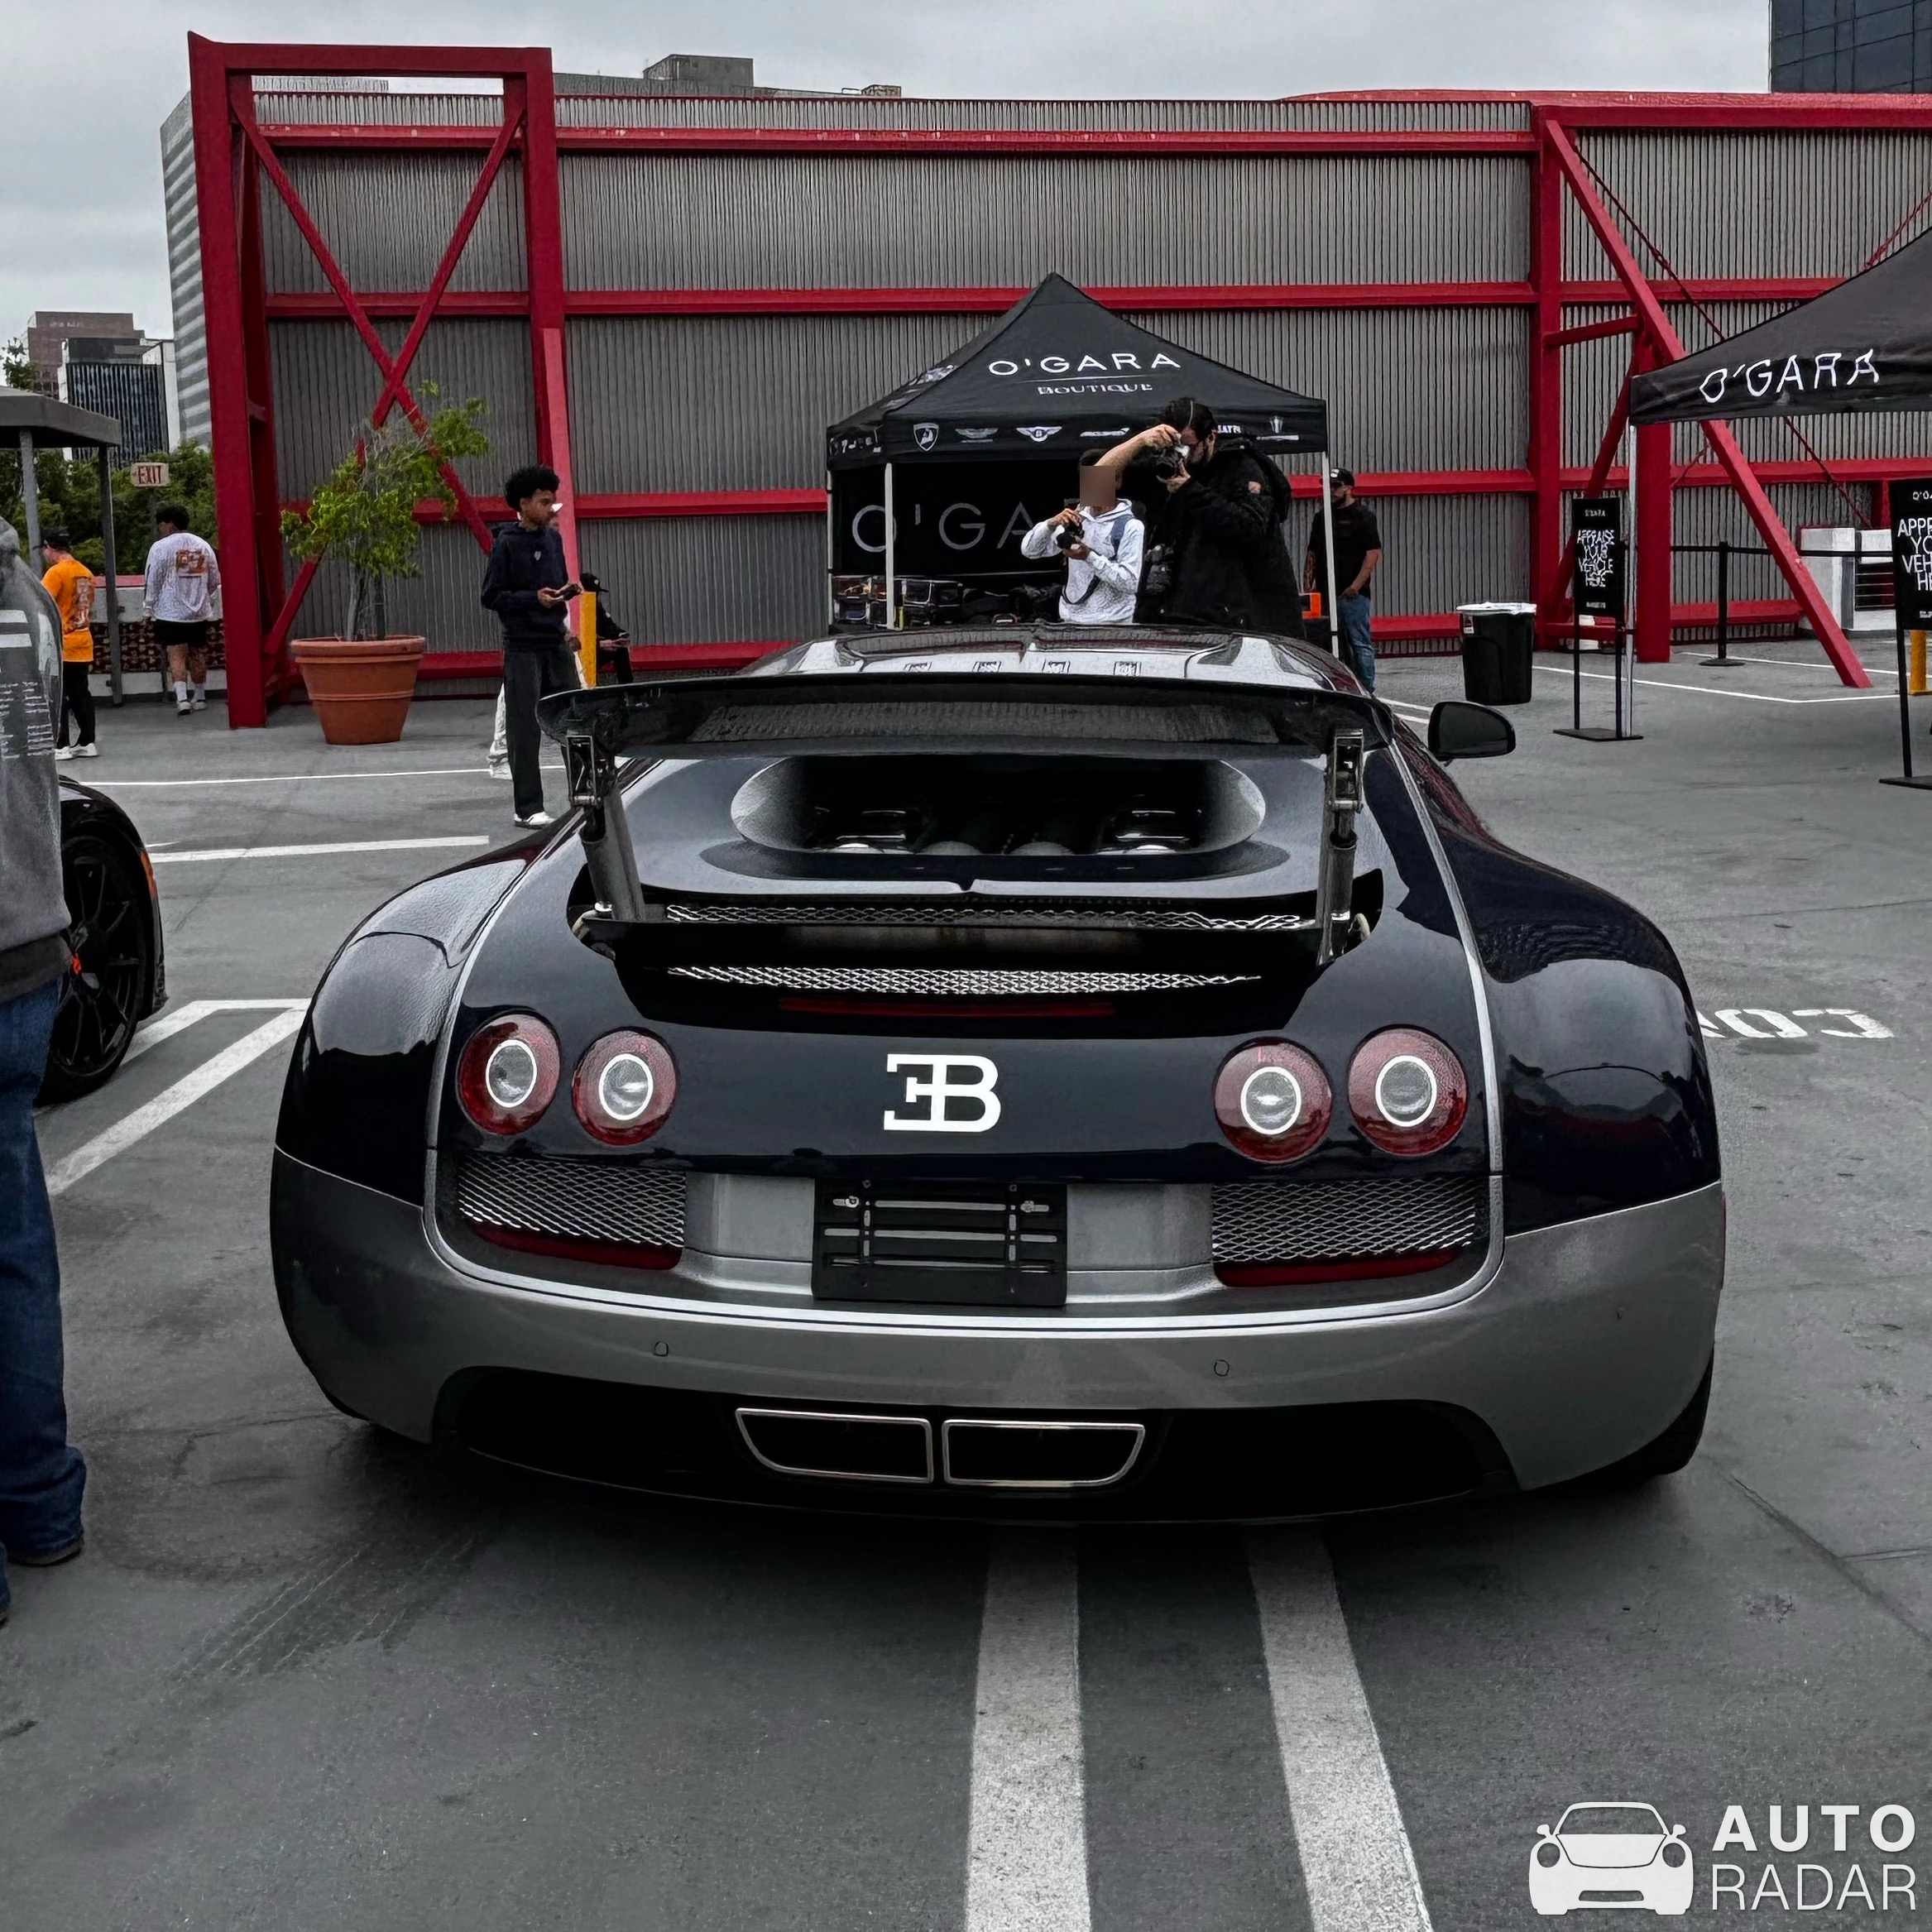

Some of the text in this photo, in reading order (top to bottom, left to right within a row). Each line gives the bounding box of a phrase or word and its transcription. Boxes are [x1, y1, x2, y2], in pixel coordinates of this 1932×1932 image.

[989, 353, 1181, 376] O'GARA
[1699, 348, 1879, 404] O'GARA
[1038, 383, 1153, 395] BOUTIQUE
[137, 465, 161, 484] EXIT
